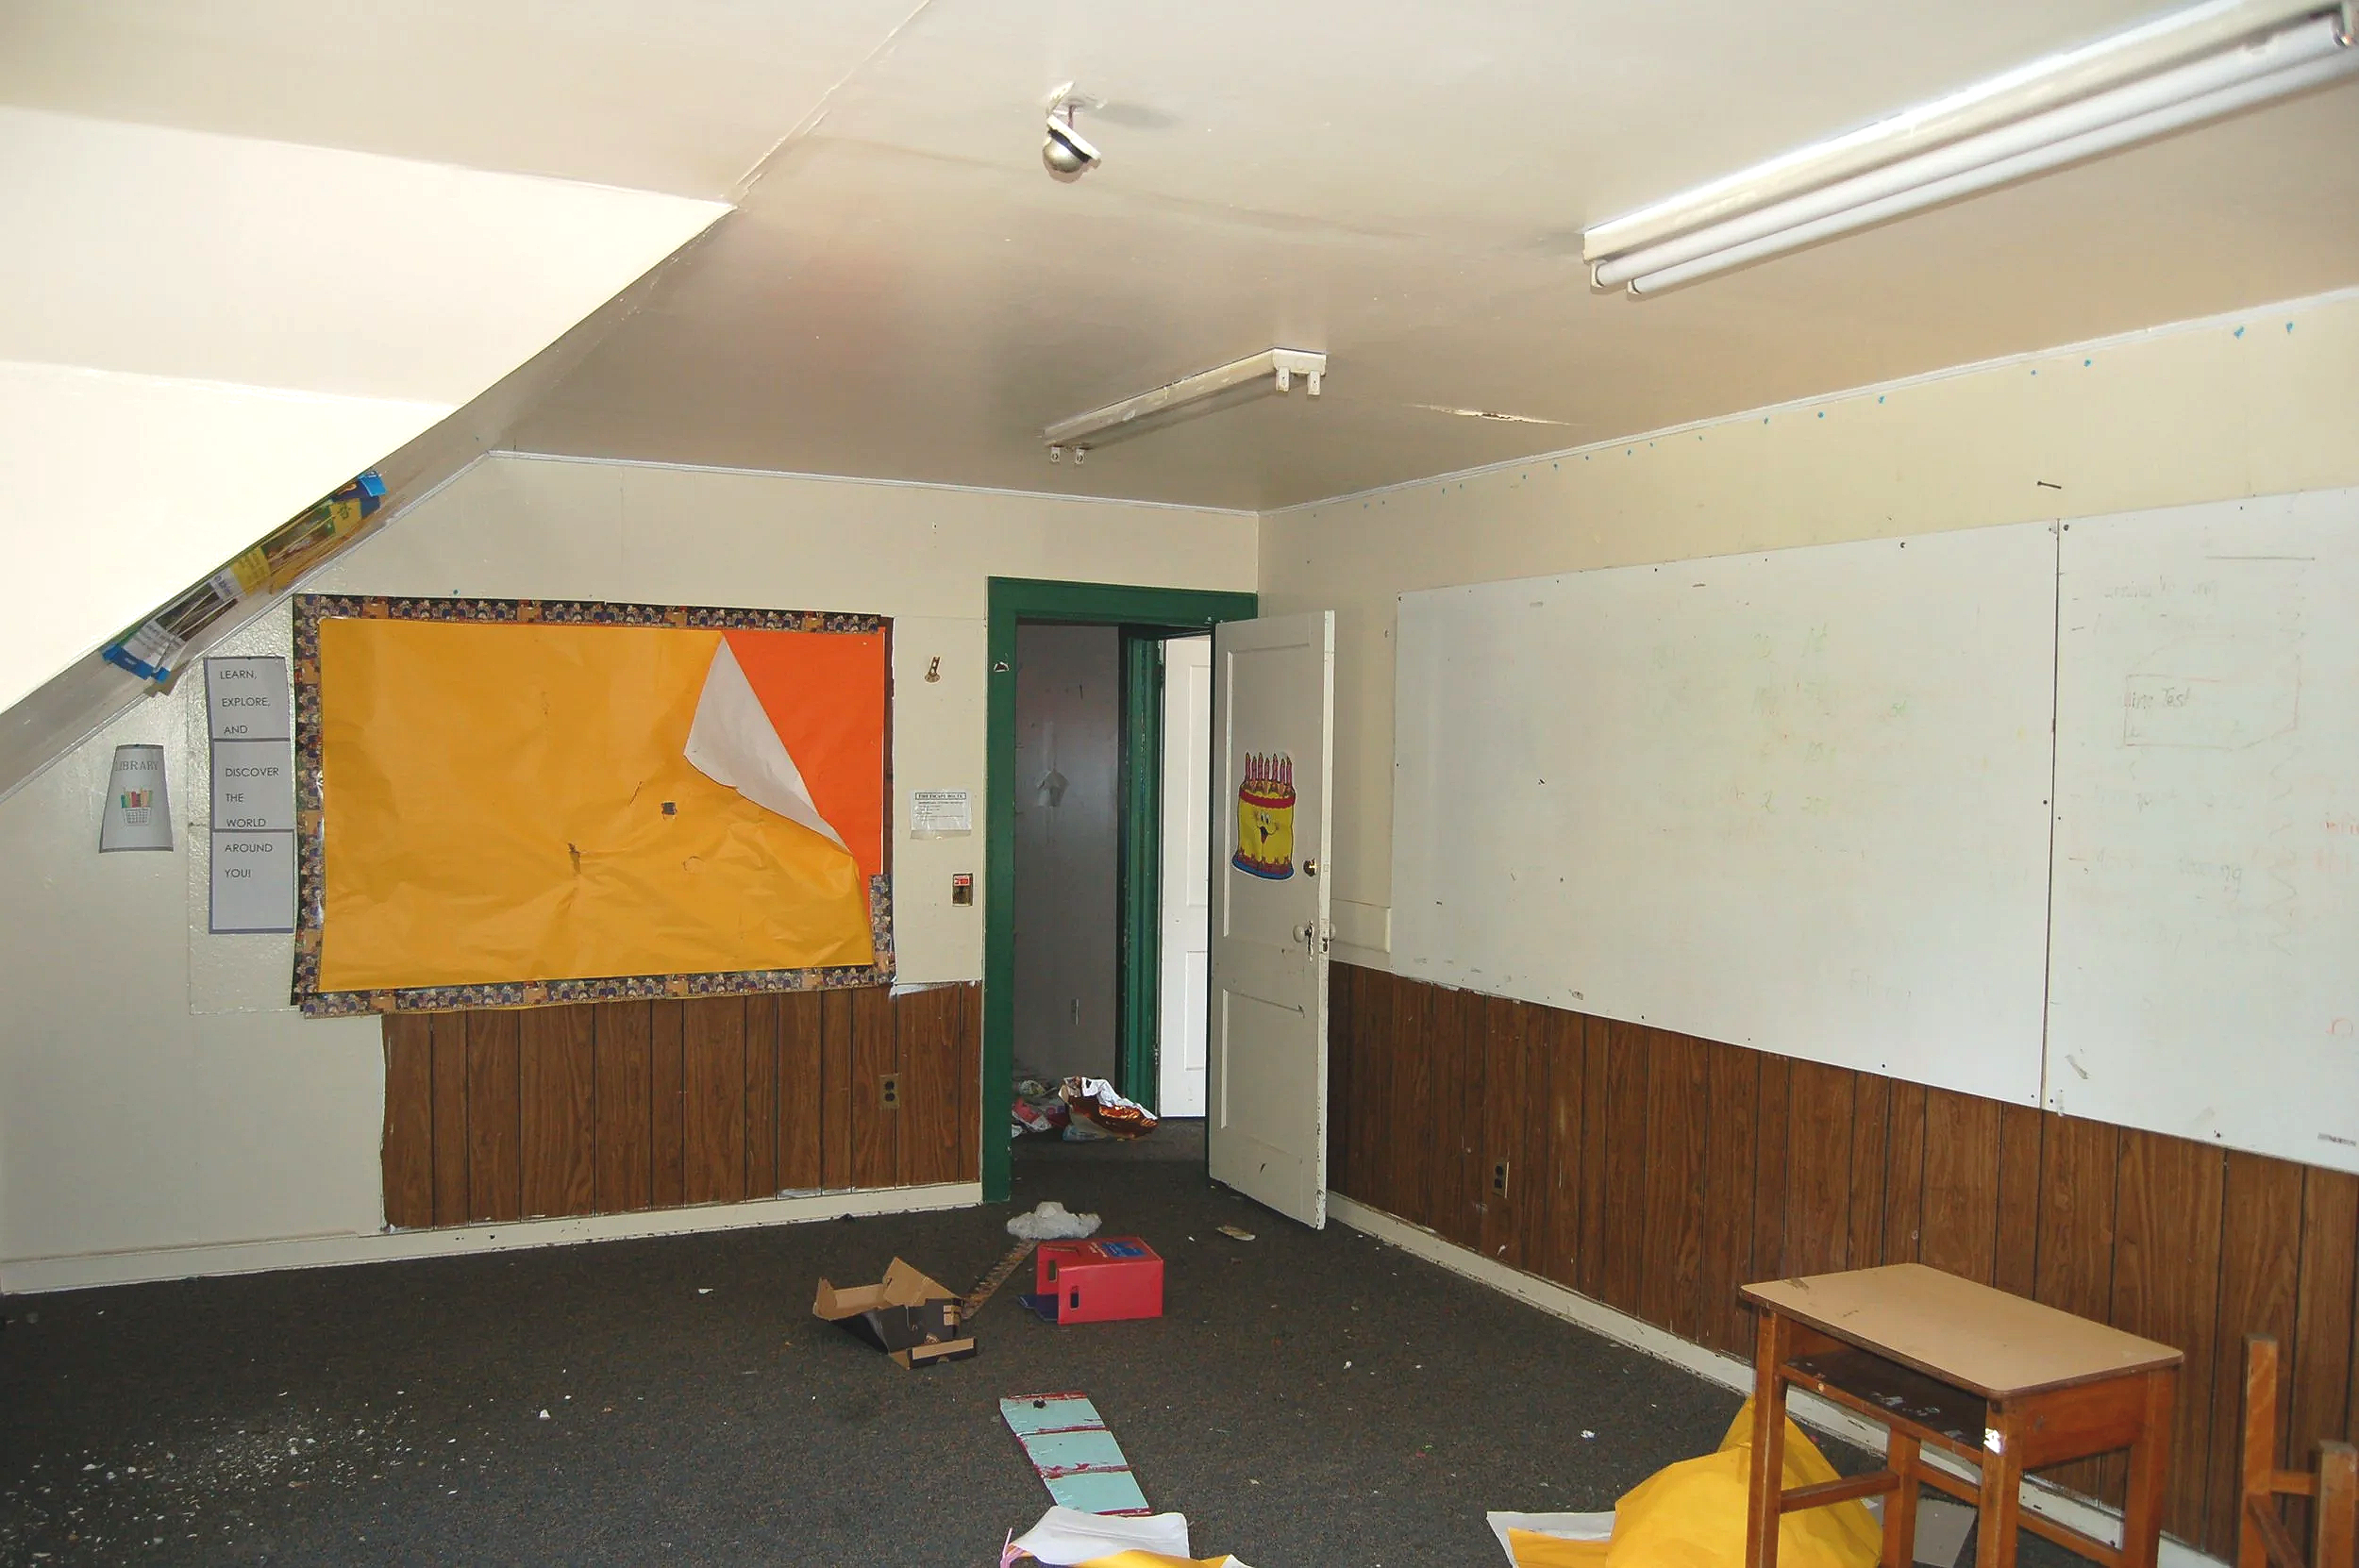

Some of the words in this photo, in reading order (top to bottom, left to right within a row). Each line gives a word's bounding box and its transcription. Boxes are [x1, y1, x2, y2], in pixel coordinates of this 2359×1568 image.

[220, 669, 258, 680] LEARN,
[221, 696, 271, 708] EXPLORE,
[223, 725, 248, 735] AND
[114, 760, 159, 772] LIBRARY
[225, 767, 279, 777] DISCOVER
[226, 792, 244, 803] THE
[226, 817, 266, 827] WORLD
[225, 843, 273, 853] AROUND
[225, 868, 251, 878] YOU!
